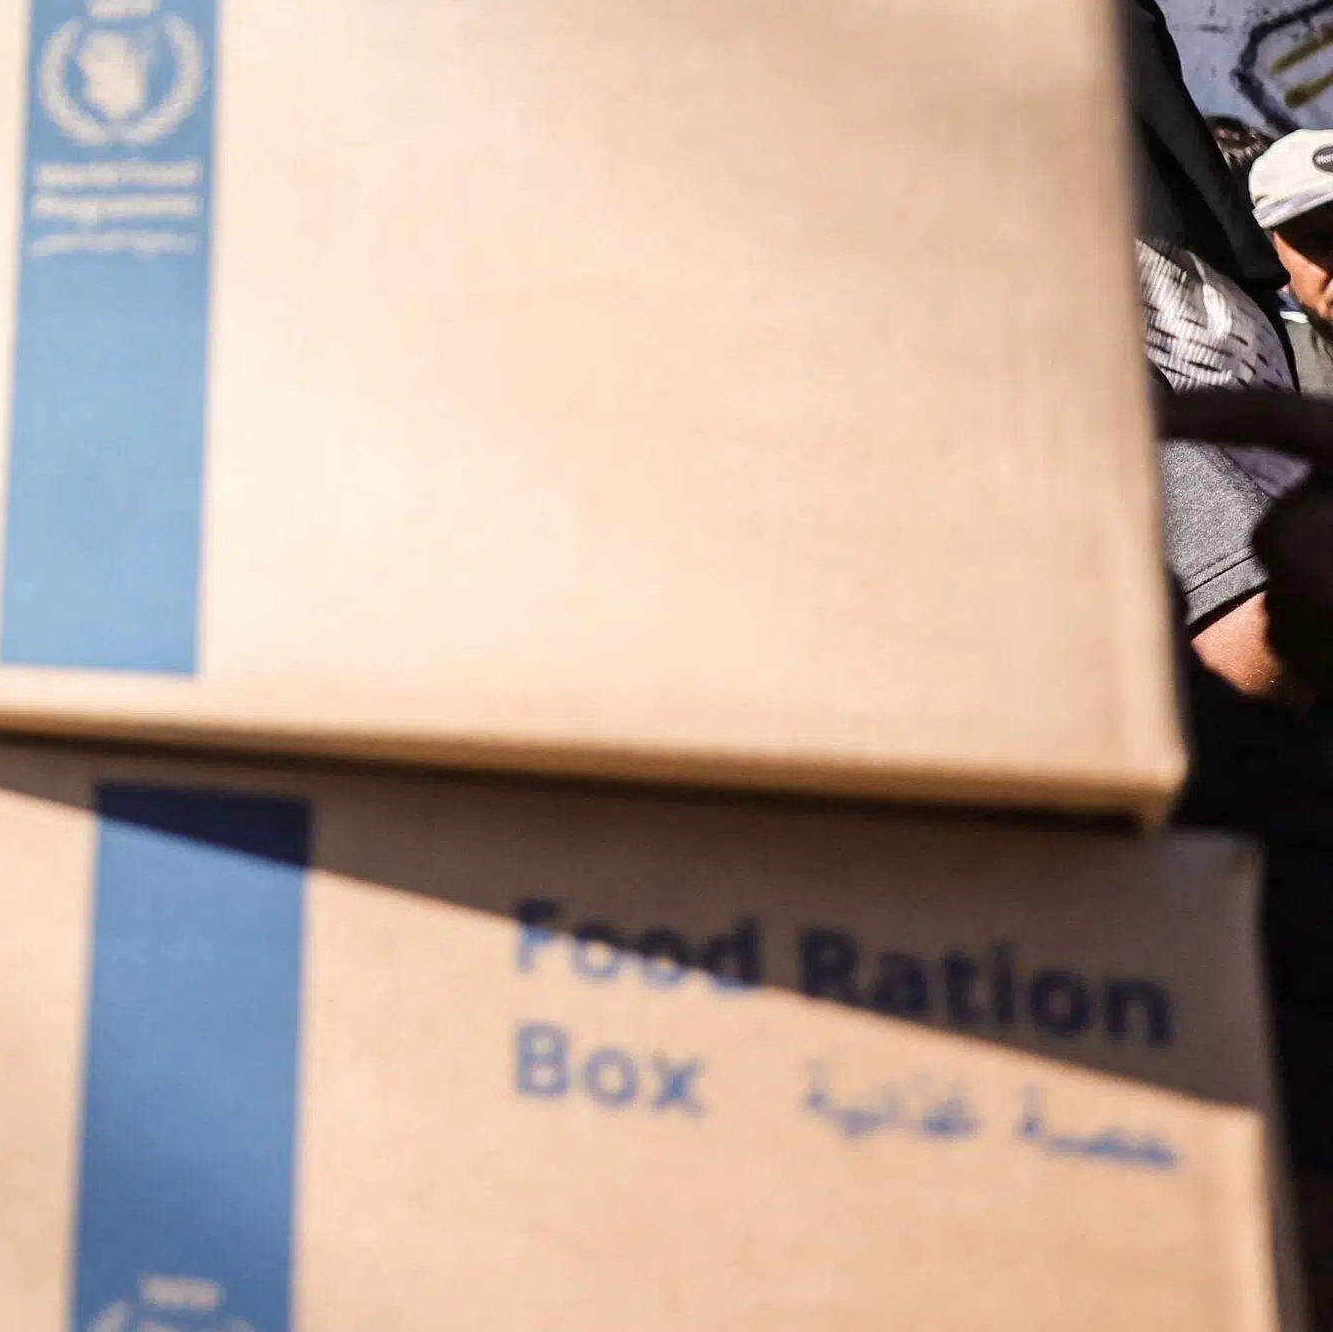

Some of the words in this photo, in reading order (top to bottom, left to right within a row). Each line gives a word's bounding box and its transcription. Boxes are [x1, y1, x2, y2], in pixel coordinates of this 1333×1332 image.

[515, 898, 762, 993] Food
[799, 927, 1175, 1048] Ration
[514, 1021, 704, 1119] Box
